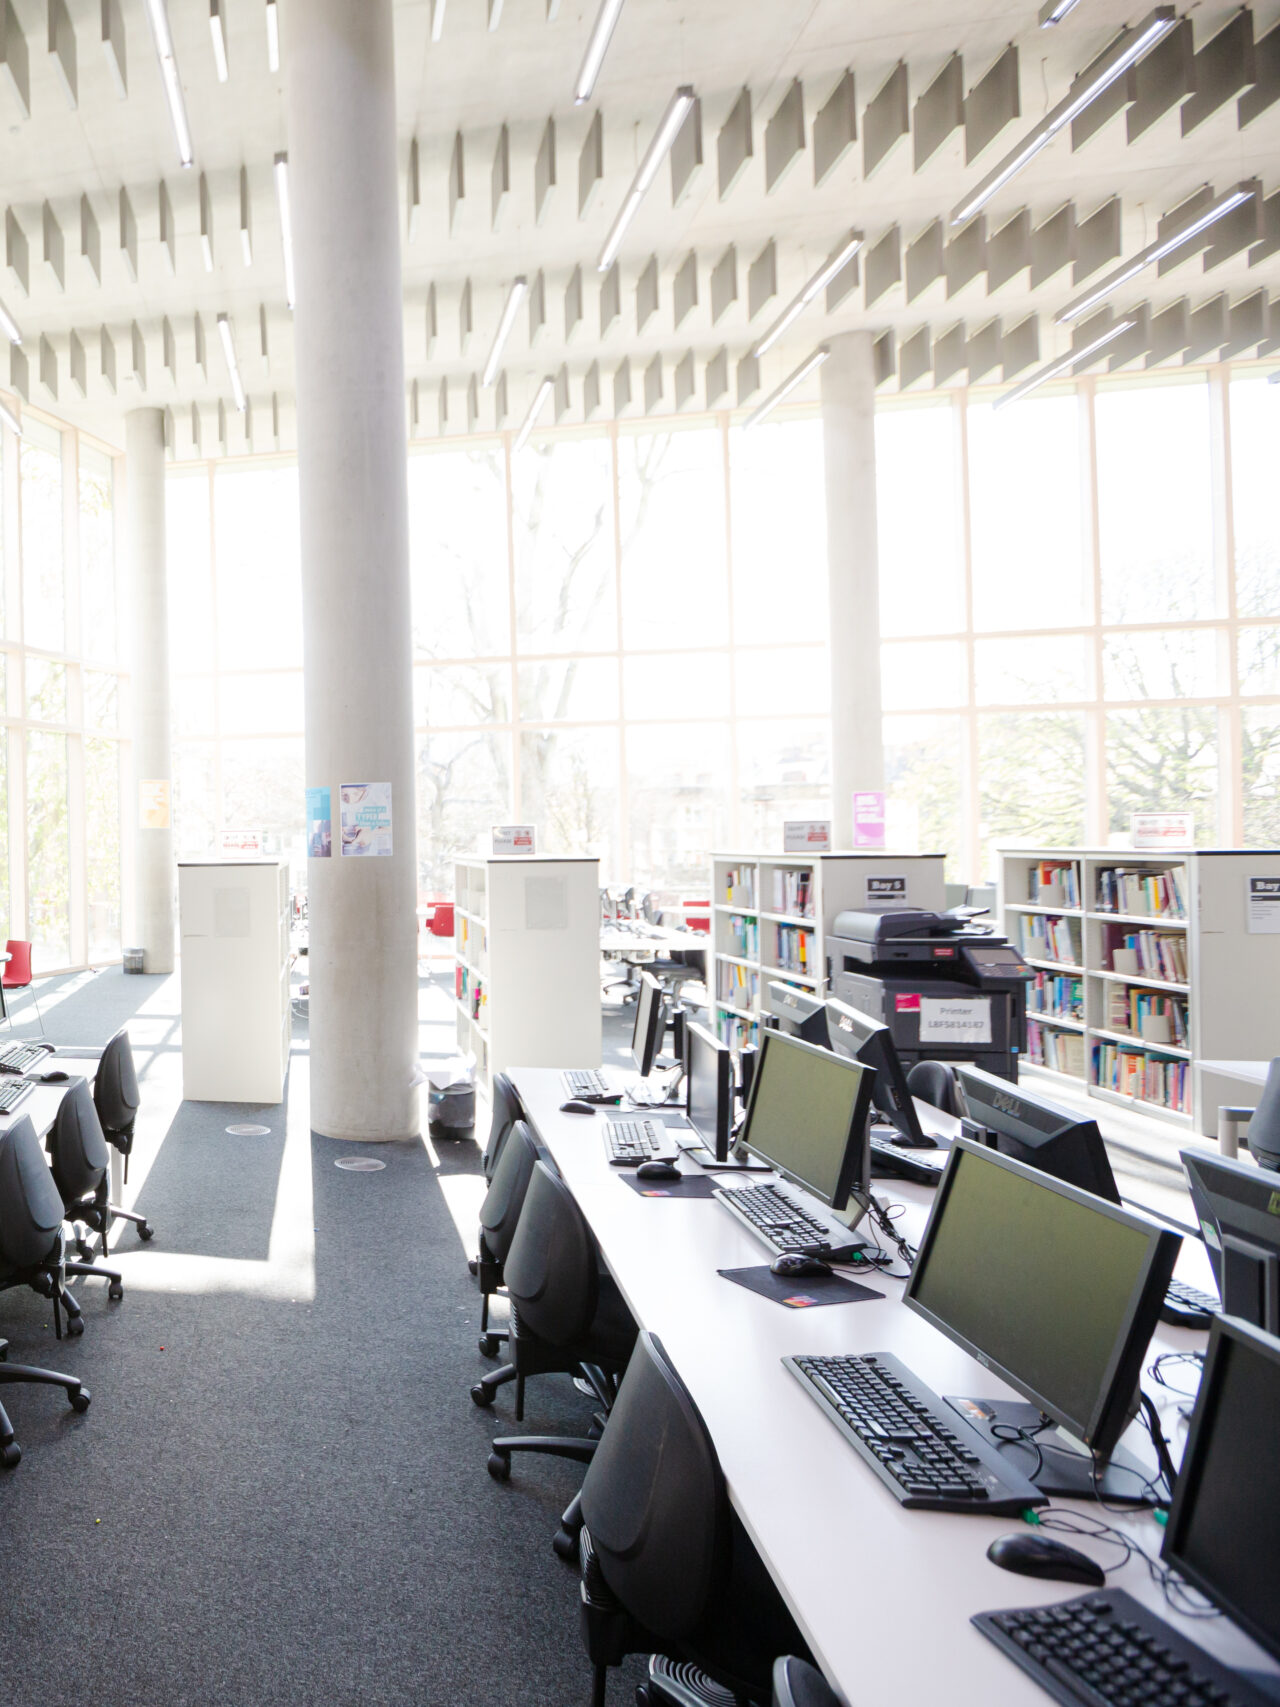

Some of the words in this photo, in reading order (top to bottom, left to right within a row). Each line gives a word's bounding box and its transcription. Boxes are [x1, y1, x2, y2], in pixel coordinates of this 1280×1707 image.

[872, 881, 892, 891] Bay
[1256, 881, 1280, 891] Bay
[940, 1007, 973, 1015] Printer
[993, 1092, 1020, 1117] DELL
